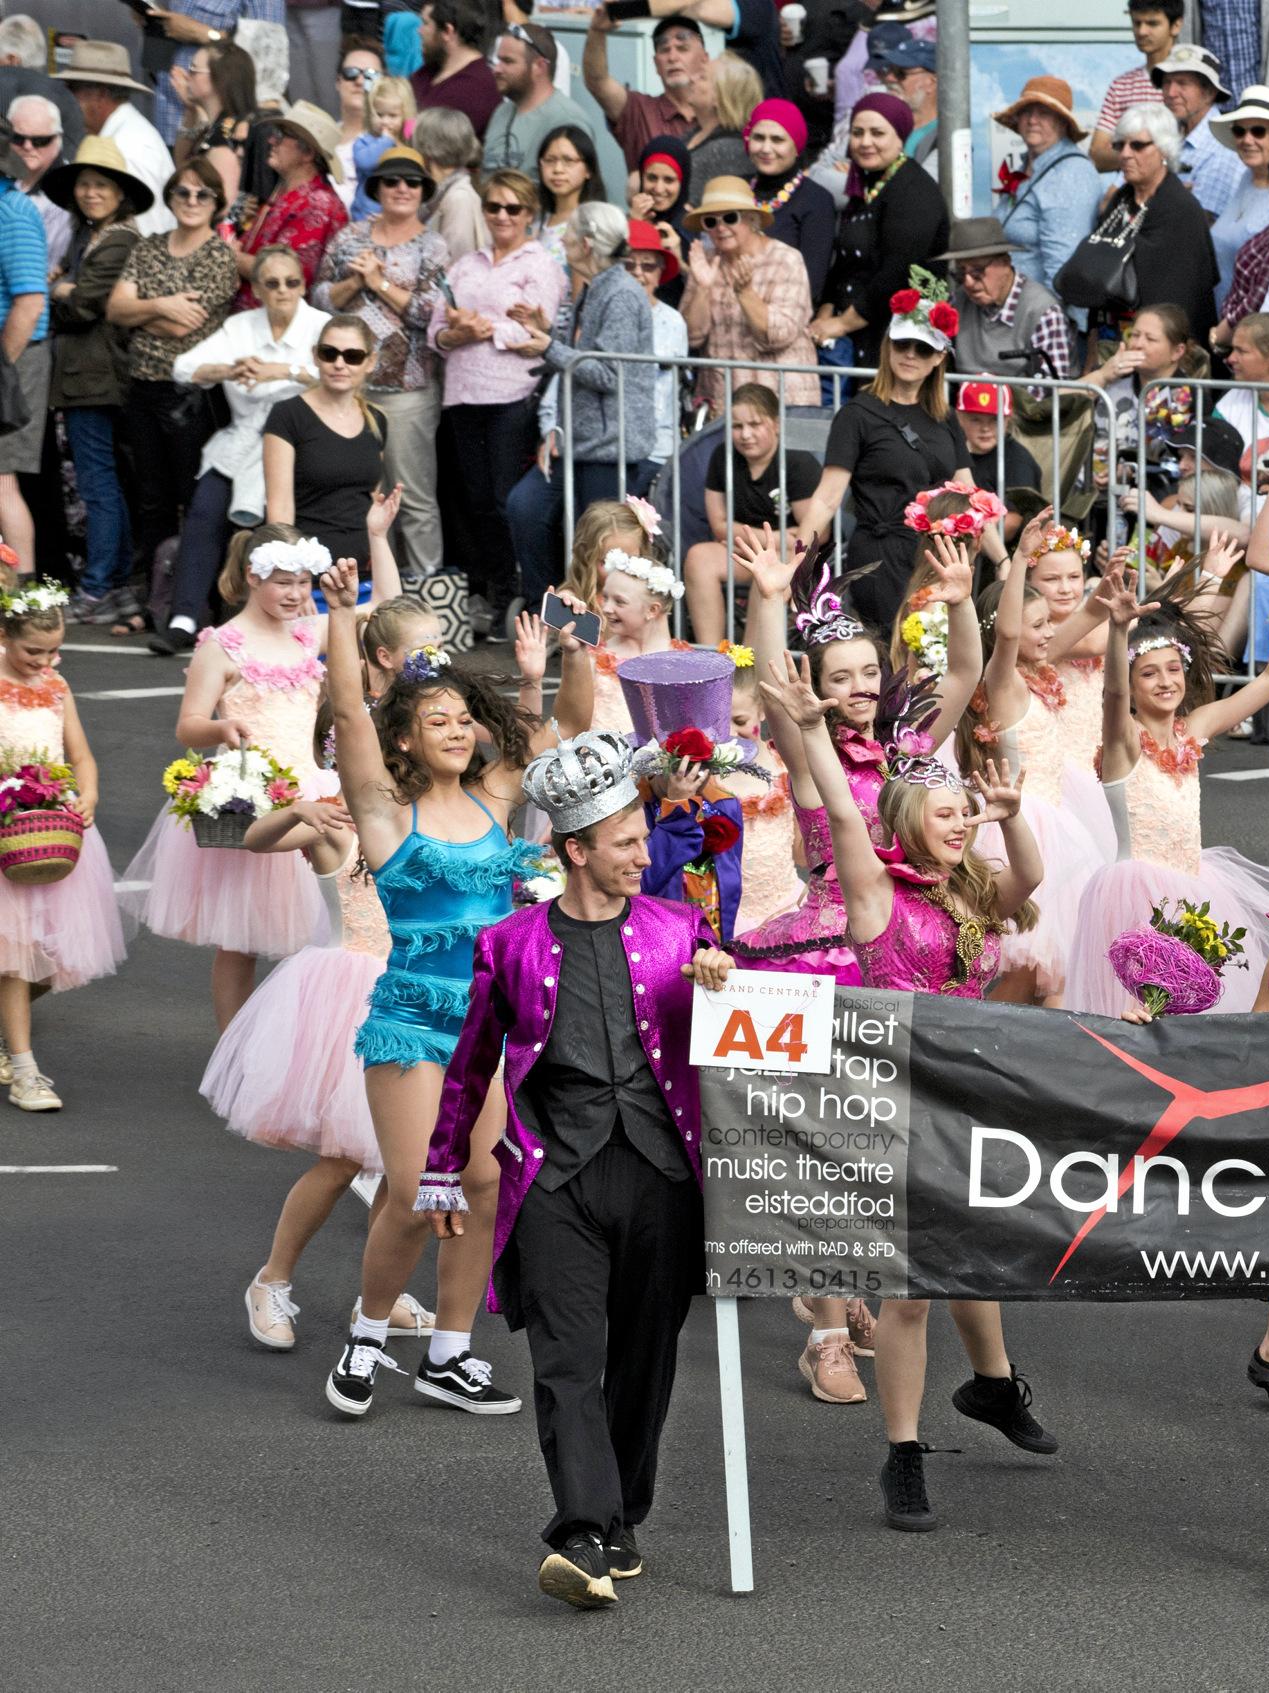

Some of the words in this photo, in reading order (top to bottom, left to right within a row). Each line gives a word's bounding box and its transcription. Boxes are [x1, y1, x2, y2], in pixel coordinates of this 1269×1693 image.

[722, 983, 755, 994] RAND
[760, 986, 819, 998] CENTRAL
[713, 1009, 808, 1062] A4
[832, 1048, 898, 1088] tap
[747, 1083, 806, 1123] hip
[819, 1086, 897, 1128] hop
[708, 1124, 895, 1155] contemporary
[707, 1152, 788, 1180] music
[795, 1154, 894, 1184] theatre
[745, 1189, 894, 1217] eisteddfod
[797, 1215, 895, 1231] preparation
[729, 1239, 782, 1255] offered
[785, 1240, 815, 1255] with
[818, 1240, 849, 1256] RAD
[852, 1241, 865, 1257] &
[867, 1241, 896, 1257] SFD
[726, 1267, 798, 1290] 4613
[809, 1268, 883, 1292] 0415
